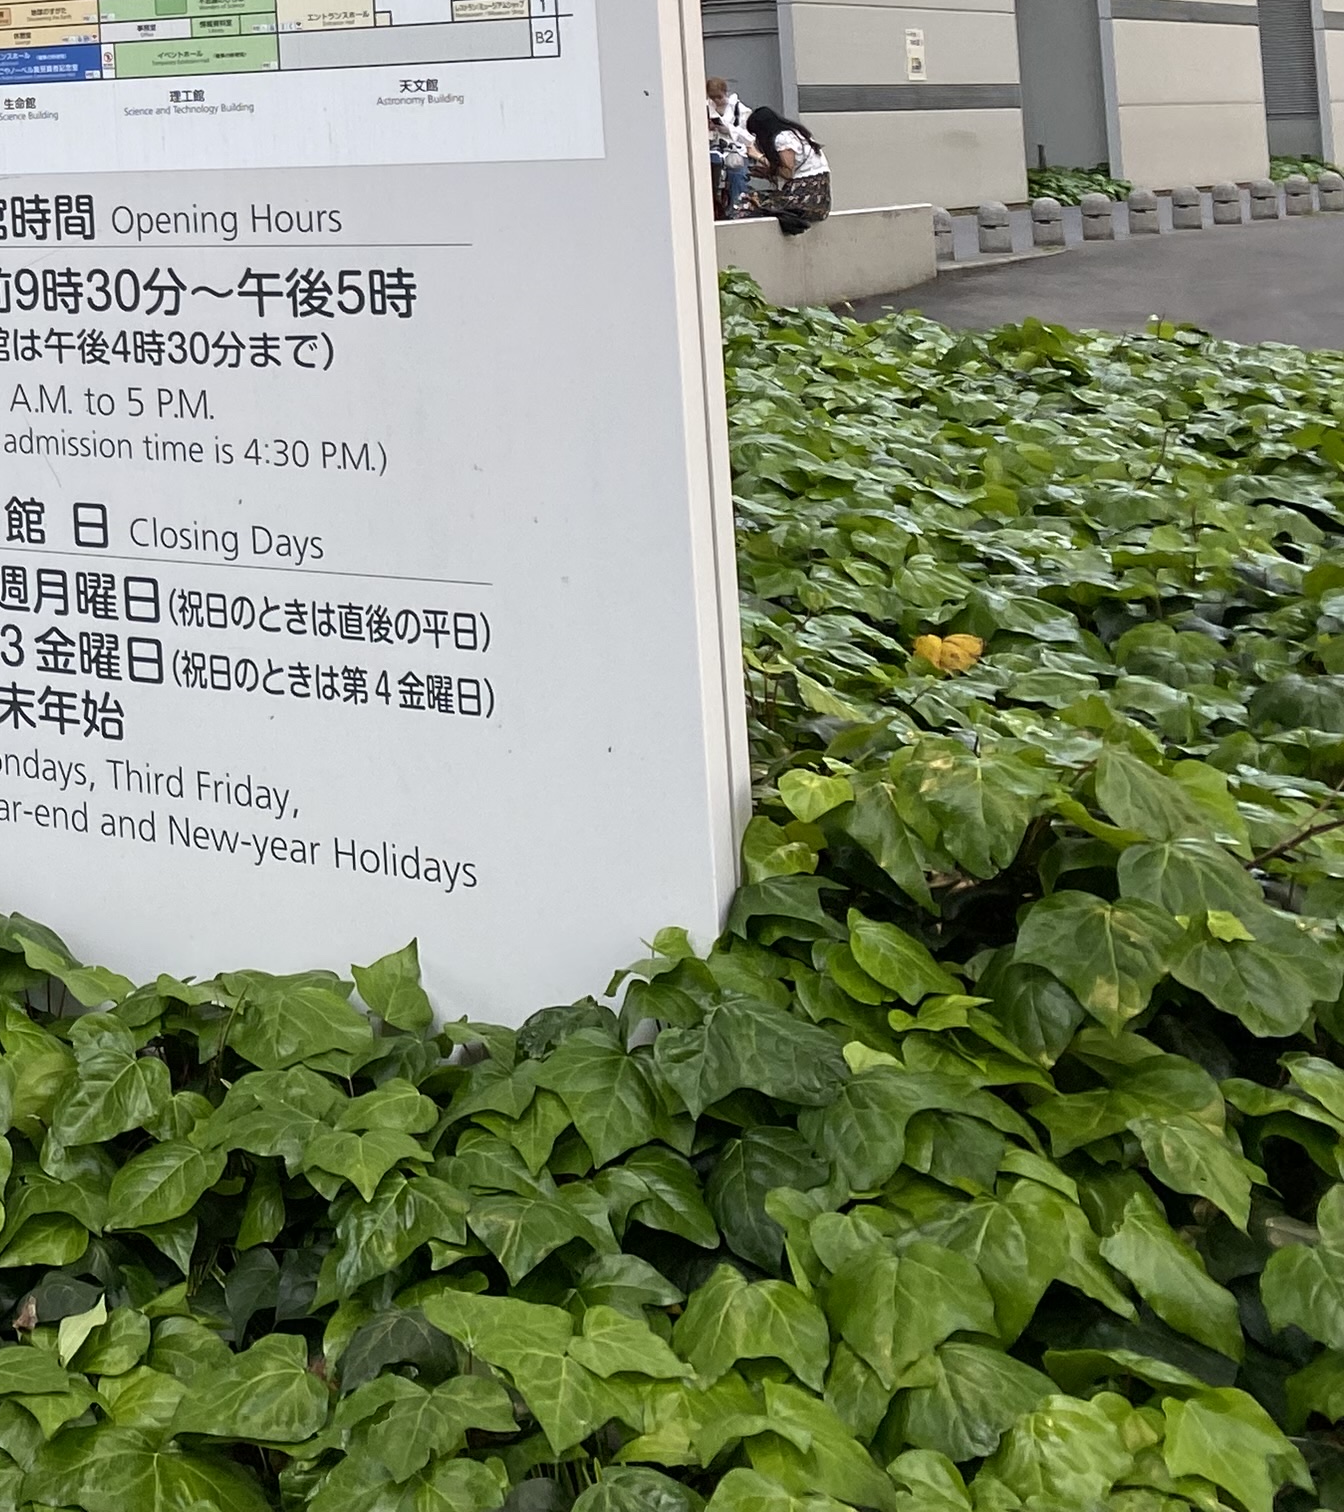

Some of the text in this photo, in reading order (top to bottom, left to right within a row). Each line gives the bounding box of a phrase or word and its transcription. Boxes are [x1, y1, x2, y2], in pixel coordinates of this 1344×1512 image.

[539, 0, 545, 12] 1
[535, 30, 554, 45] B2
[399, 79, 439, 93] 天文館
[169, 90, 205, 103] 理工館
[377, 93, 464, 106] Astronomy Building
[3, 98, 37, 110] 生命館
[124, 102, 254, 116] Science and Technology Building
[29, 110, 59, 121] Building
[111, 203, 238, 240] Opening
[250, 202, 343, 235] Hours
[9, 383, 74, 415] A.M.
[84, 387, 115, 416] to
[127, 389, 145, 417] 5
[157, 390, 215, 421] P.M.
[4, 428, 134, 461] admission
[142, 435, 206, 463] time
[214, 438, 234, 465] is
[244, 439, 310, 468] 4:30
[320, 440, 389, 476] P.M.)
[129, 517, 240, 561] Closing
[251, 525, 324, 562] Days
[107, 758, 184, 801] Third
[197, 770, 302, 820] Friday,
[101, 807, 156, 843] and
[169, 816, 320, 867] New-year
[333, 836, 479, 892] Holidays
